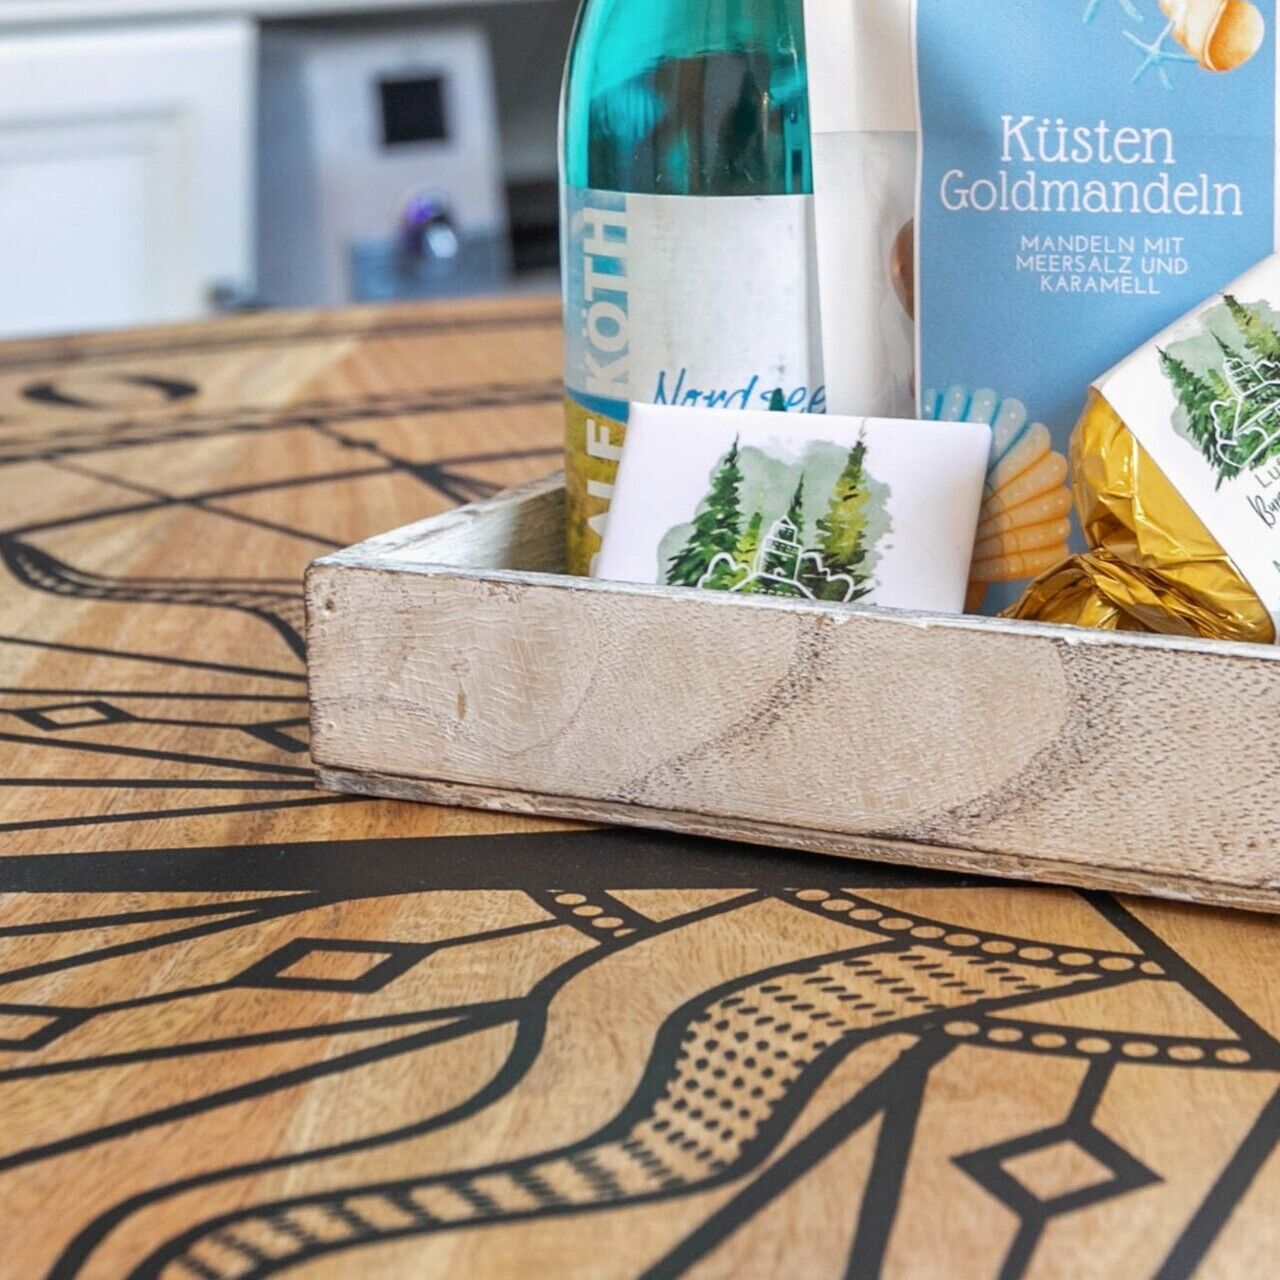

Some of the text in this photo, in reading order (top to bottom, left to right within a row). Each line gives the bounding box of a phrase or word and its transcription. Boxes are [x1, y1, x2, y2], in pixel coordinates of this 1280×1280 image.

[999, 114, 1177, 164] Küsten
[939, 168, 1244, 216] Goldmandeln
[1020, 235, 1185, 255] MANDELN MIT
[1015, 254, 1188, 276] MEERSALZ UND
[584, 206, 629, 395] KÖTH
[1040, 274, 1161, 296] KARAMELL
